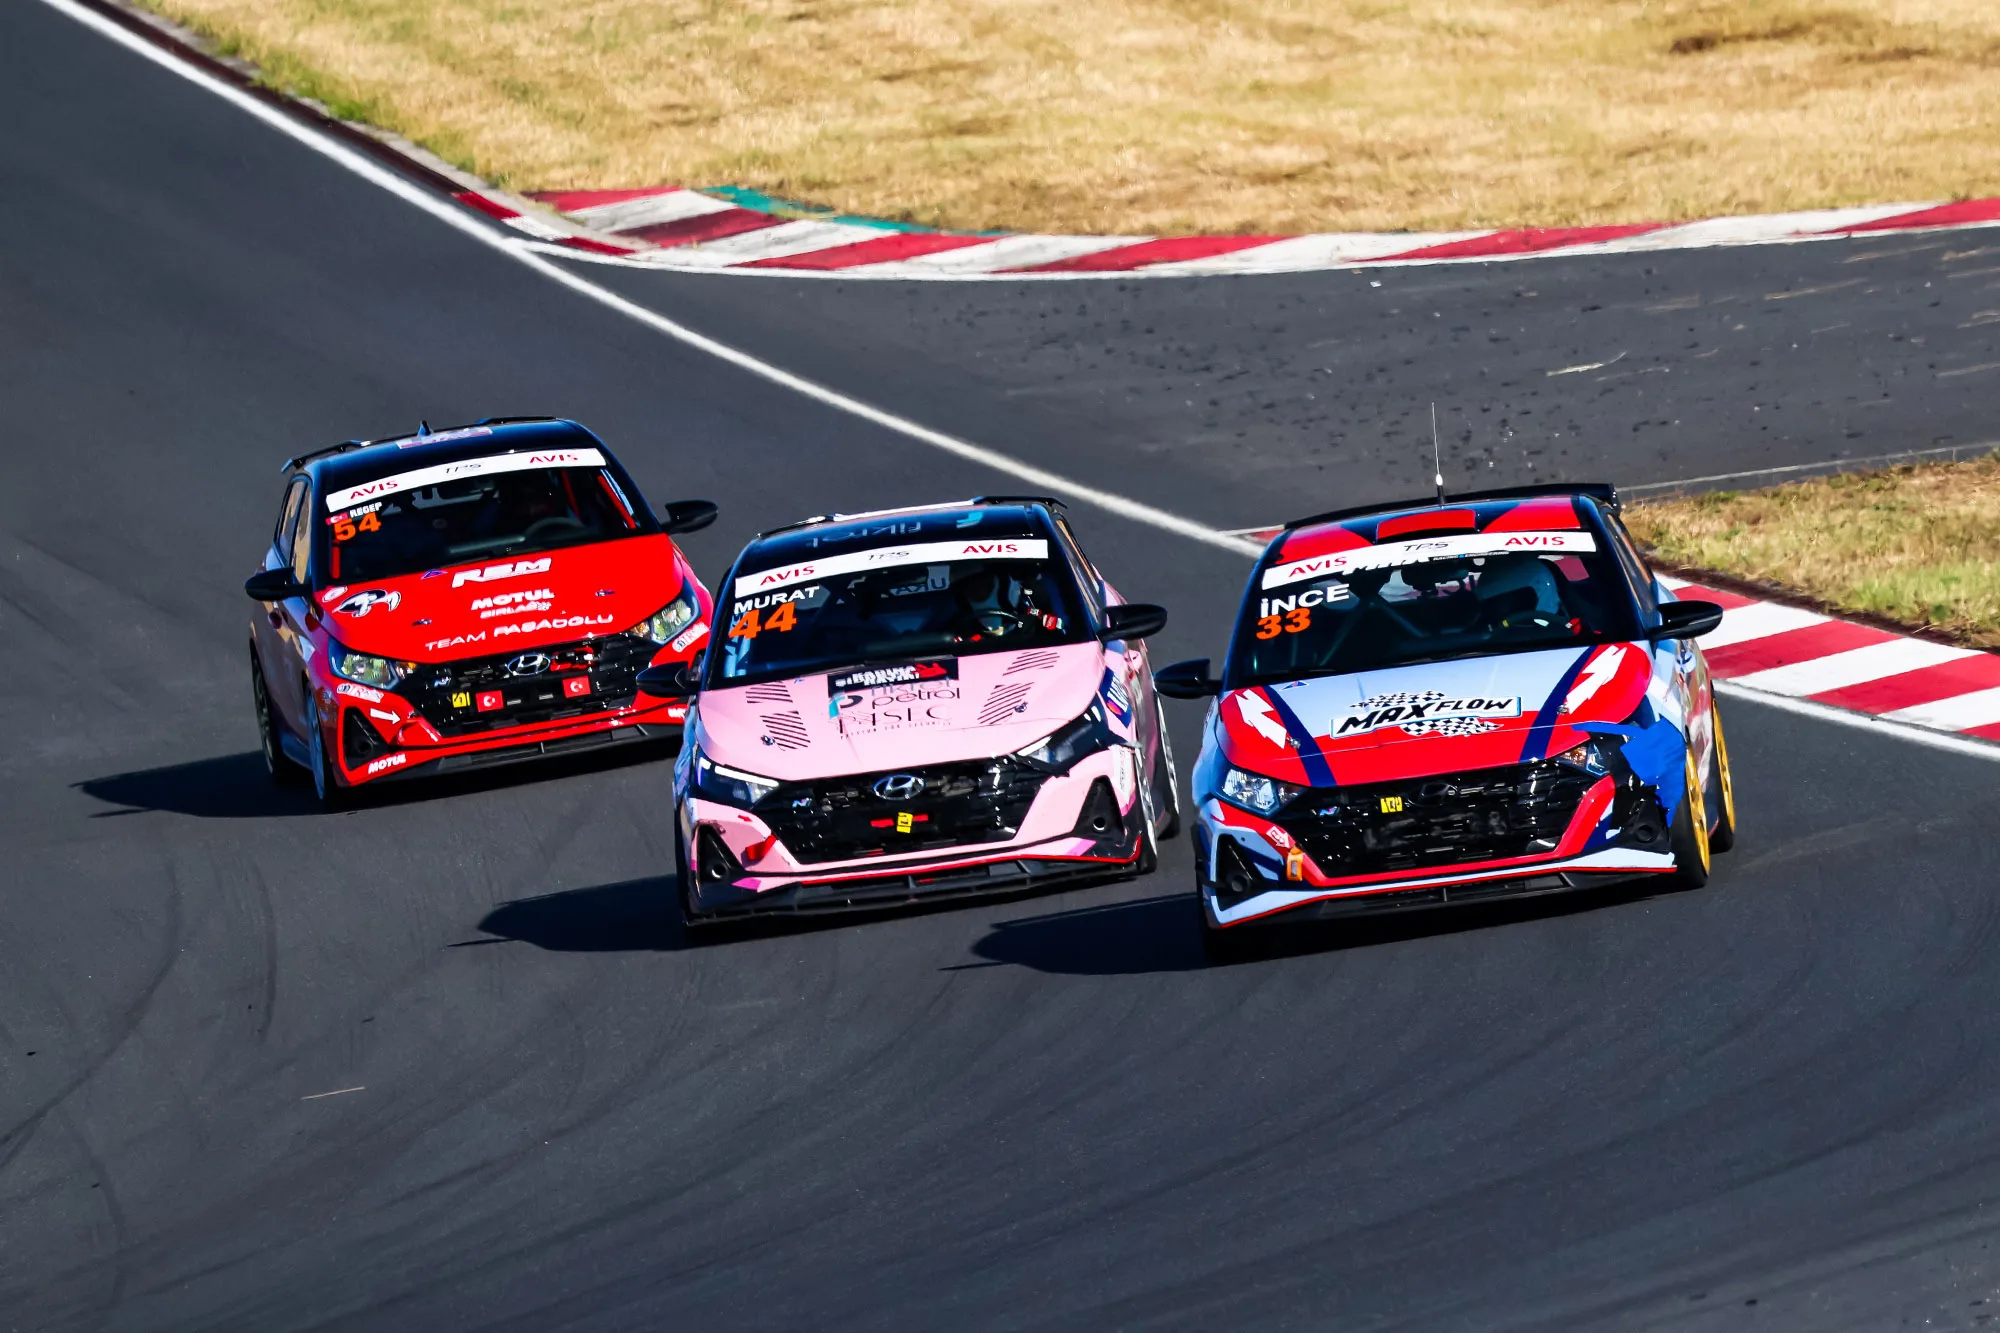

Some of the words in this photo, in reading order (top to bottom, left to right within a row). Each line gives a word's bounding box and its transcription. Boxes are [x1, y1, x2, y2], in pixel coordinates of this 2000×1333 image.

[349, 480, 398, 500] AVIS
[529, 454, 578, 464] AVIS
[333, 511, 382, 541] 54
[760, 565, 815, 586] AVIS
[962, 544, 1018, 553] AVIS
[1289, 557, 1347, 577] AVIS
[1404, 542, 1449, 552] TPS
[1505, 537, 1565, 546] AVIS
[471, 588, 555, 611] MOTUL
[734, 585, 820, 615] MURAT
[728, 602, 797, 639] 44
[1256, 608, 1311, 640] 33
[425, 631, 486, 651] TEAM
[872, 687, 961, 710] petrol
[367, 754, 406, 774] MOTUL
